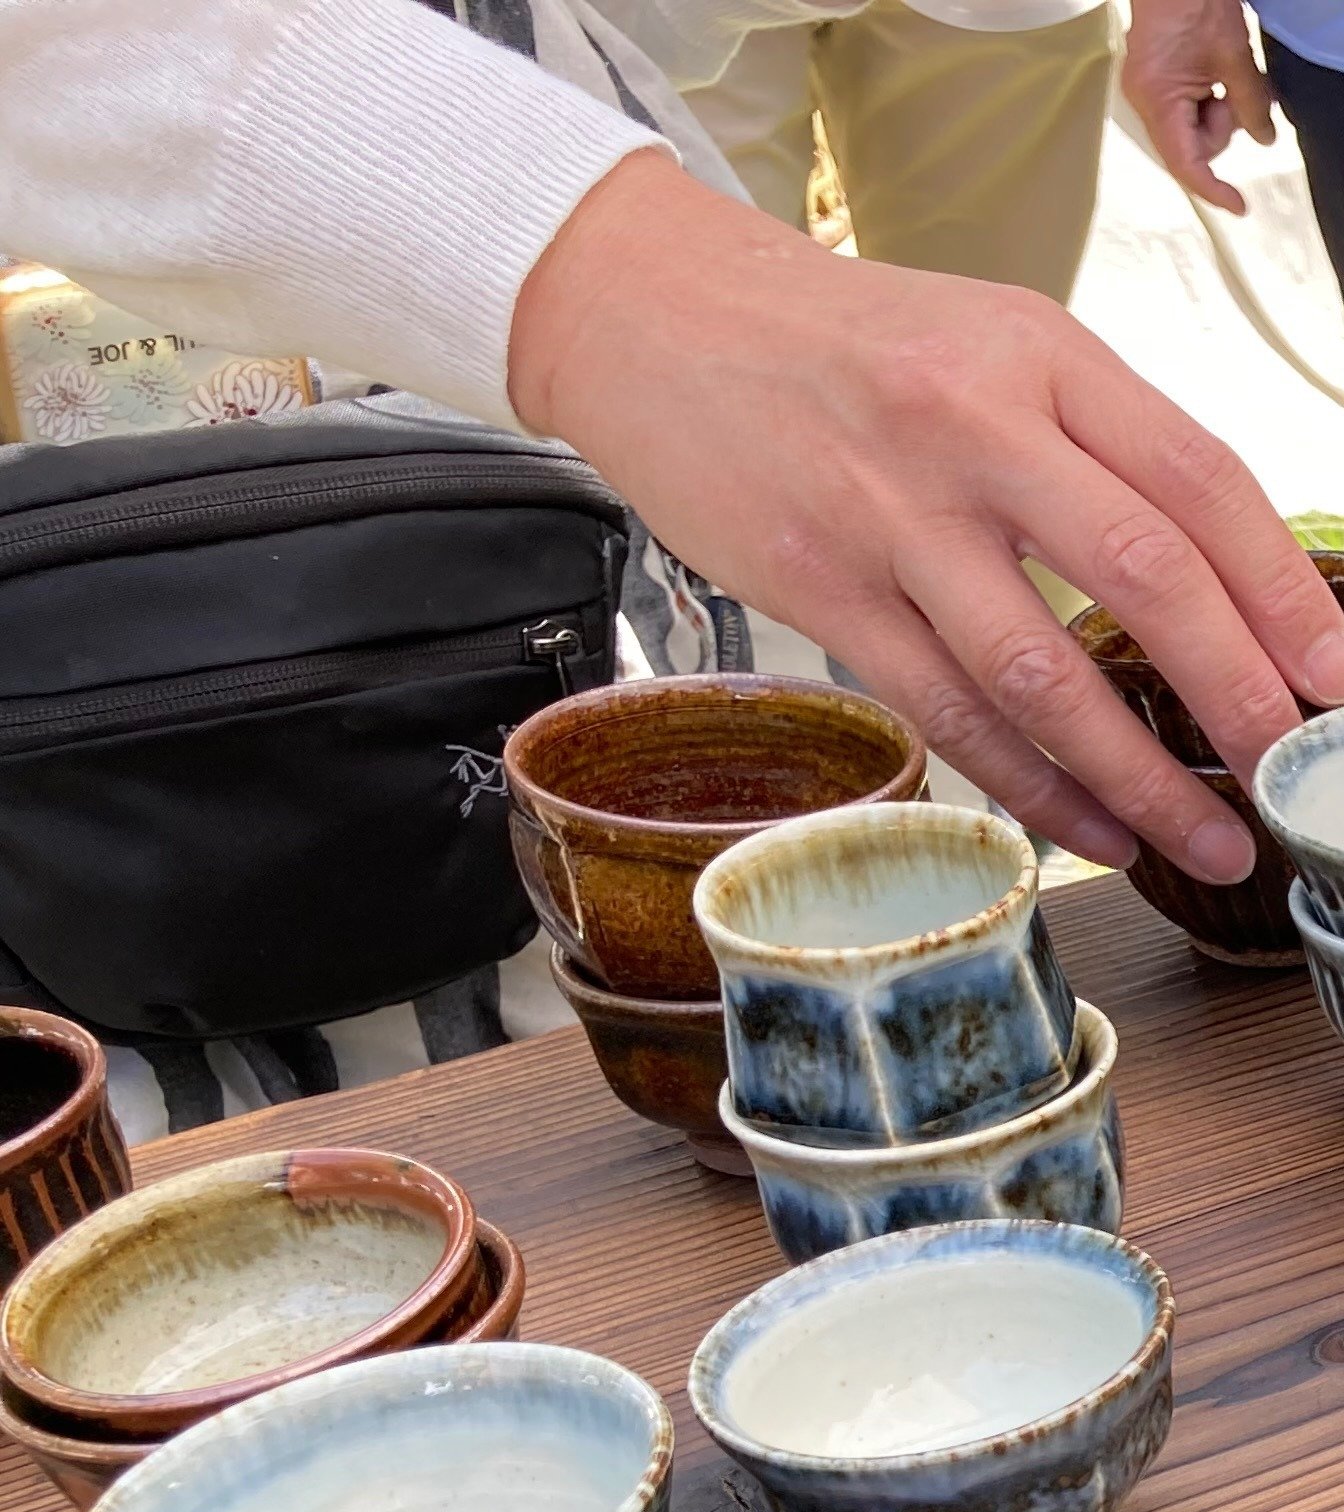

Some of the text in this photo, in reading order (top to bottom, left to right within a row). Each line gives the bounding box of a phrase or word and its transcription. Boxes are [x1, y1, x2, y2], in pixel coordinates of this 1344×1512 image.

[88, 341, 131, 366] JOE
[139, 338, 157, 356] &
[721, 609, 739, 672] DLETON
